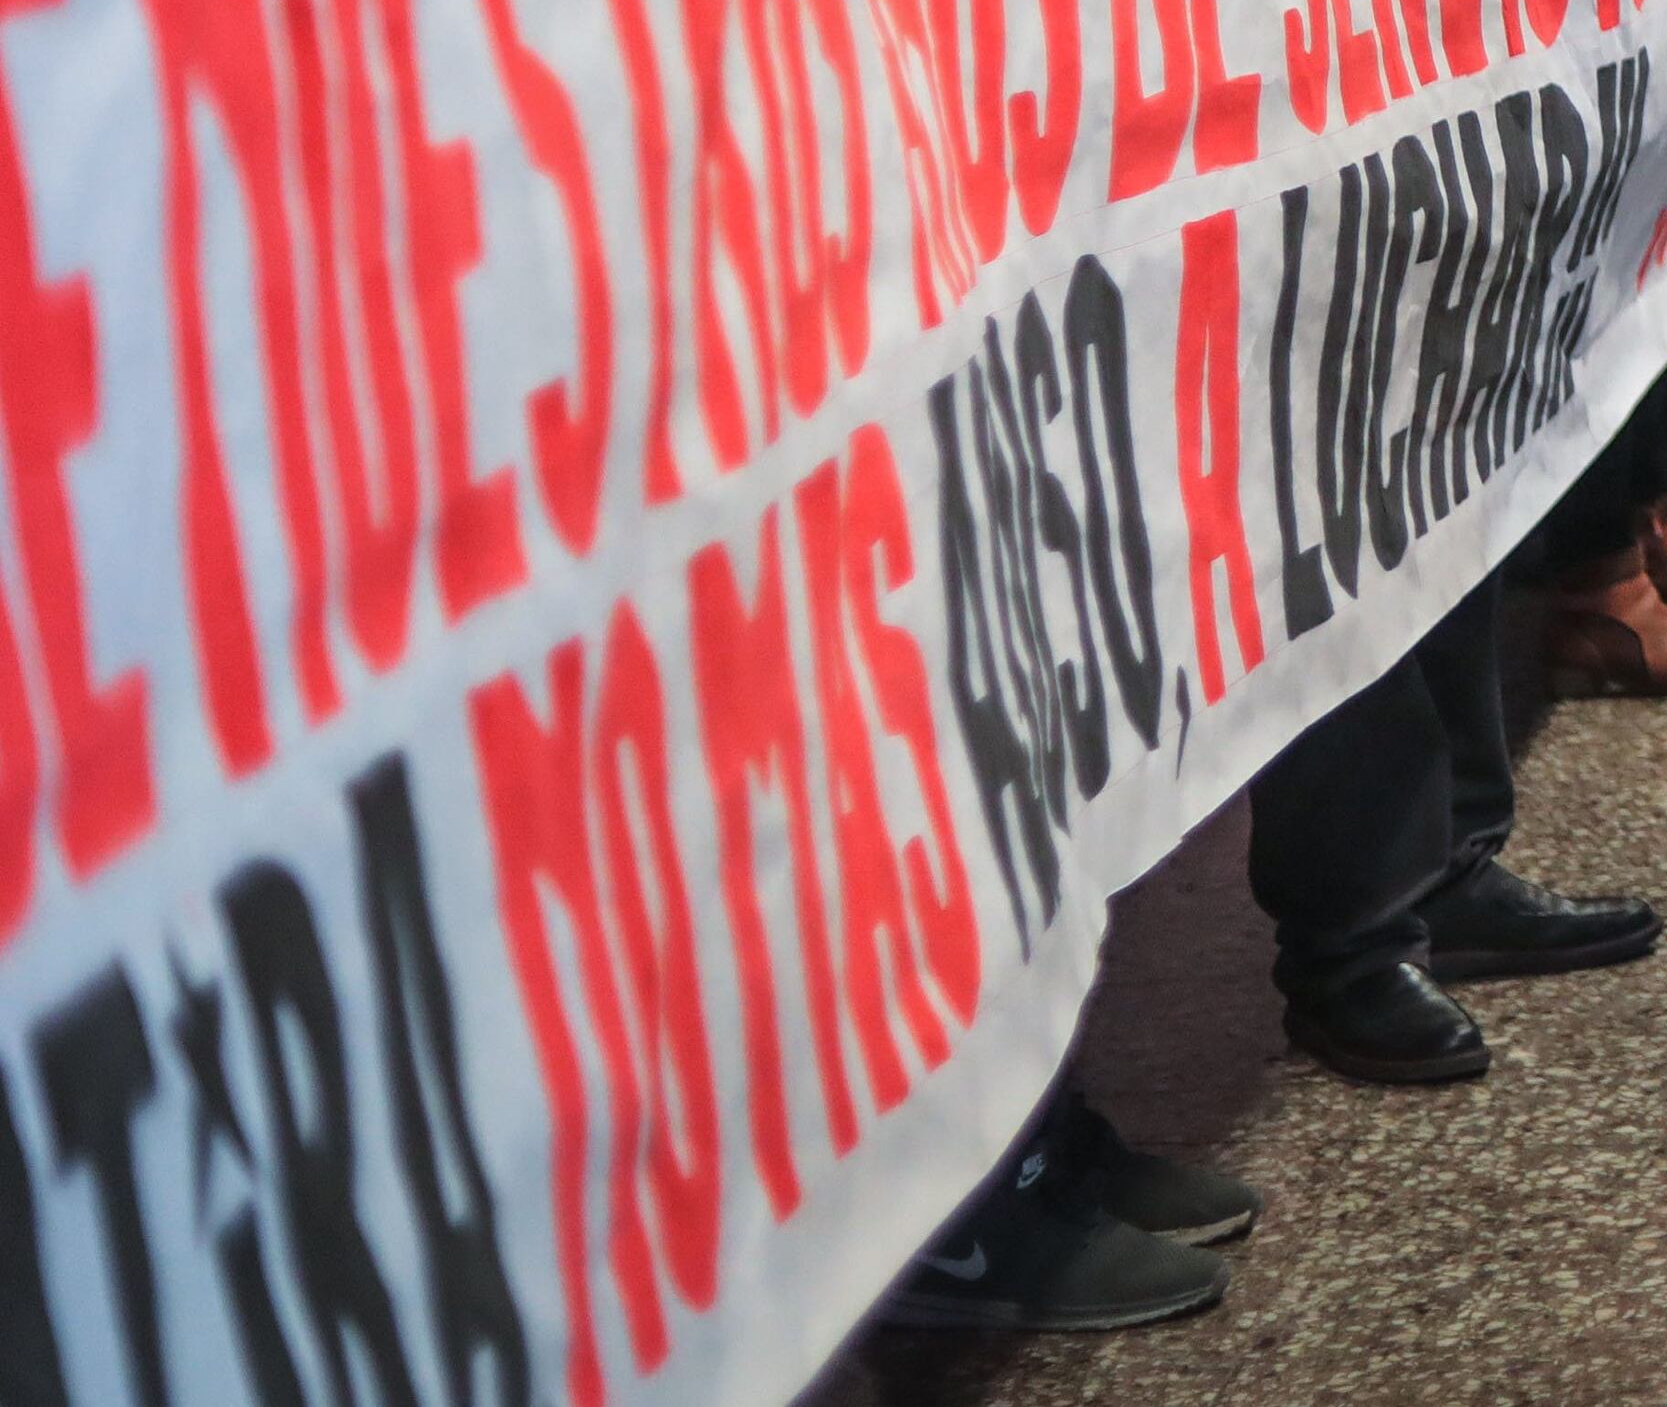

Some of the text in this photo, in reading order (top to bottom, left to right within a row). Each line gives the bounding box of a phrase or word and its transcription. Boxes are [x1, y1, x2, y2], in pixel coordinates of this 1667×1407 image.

[467, 594, 721, 1407] NO
[687, 421, 981, 1226] MAS
[1173, 207, 1265, 706] A
